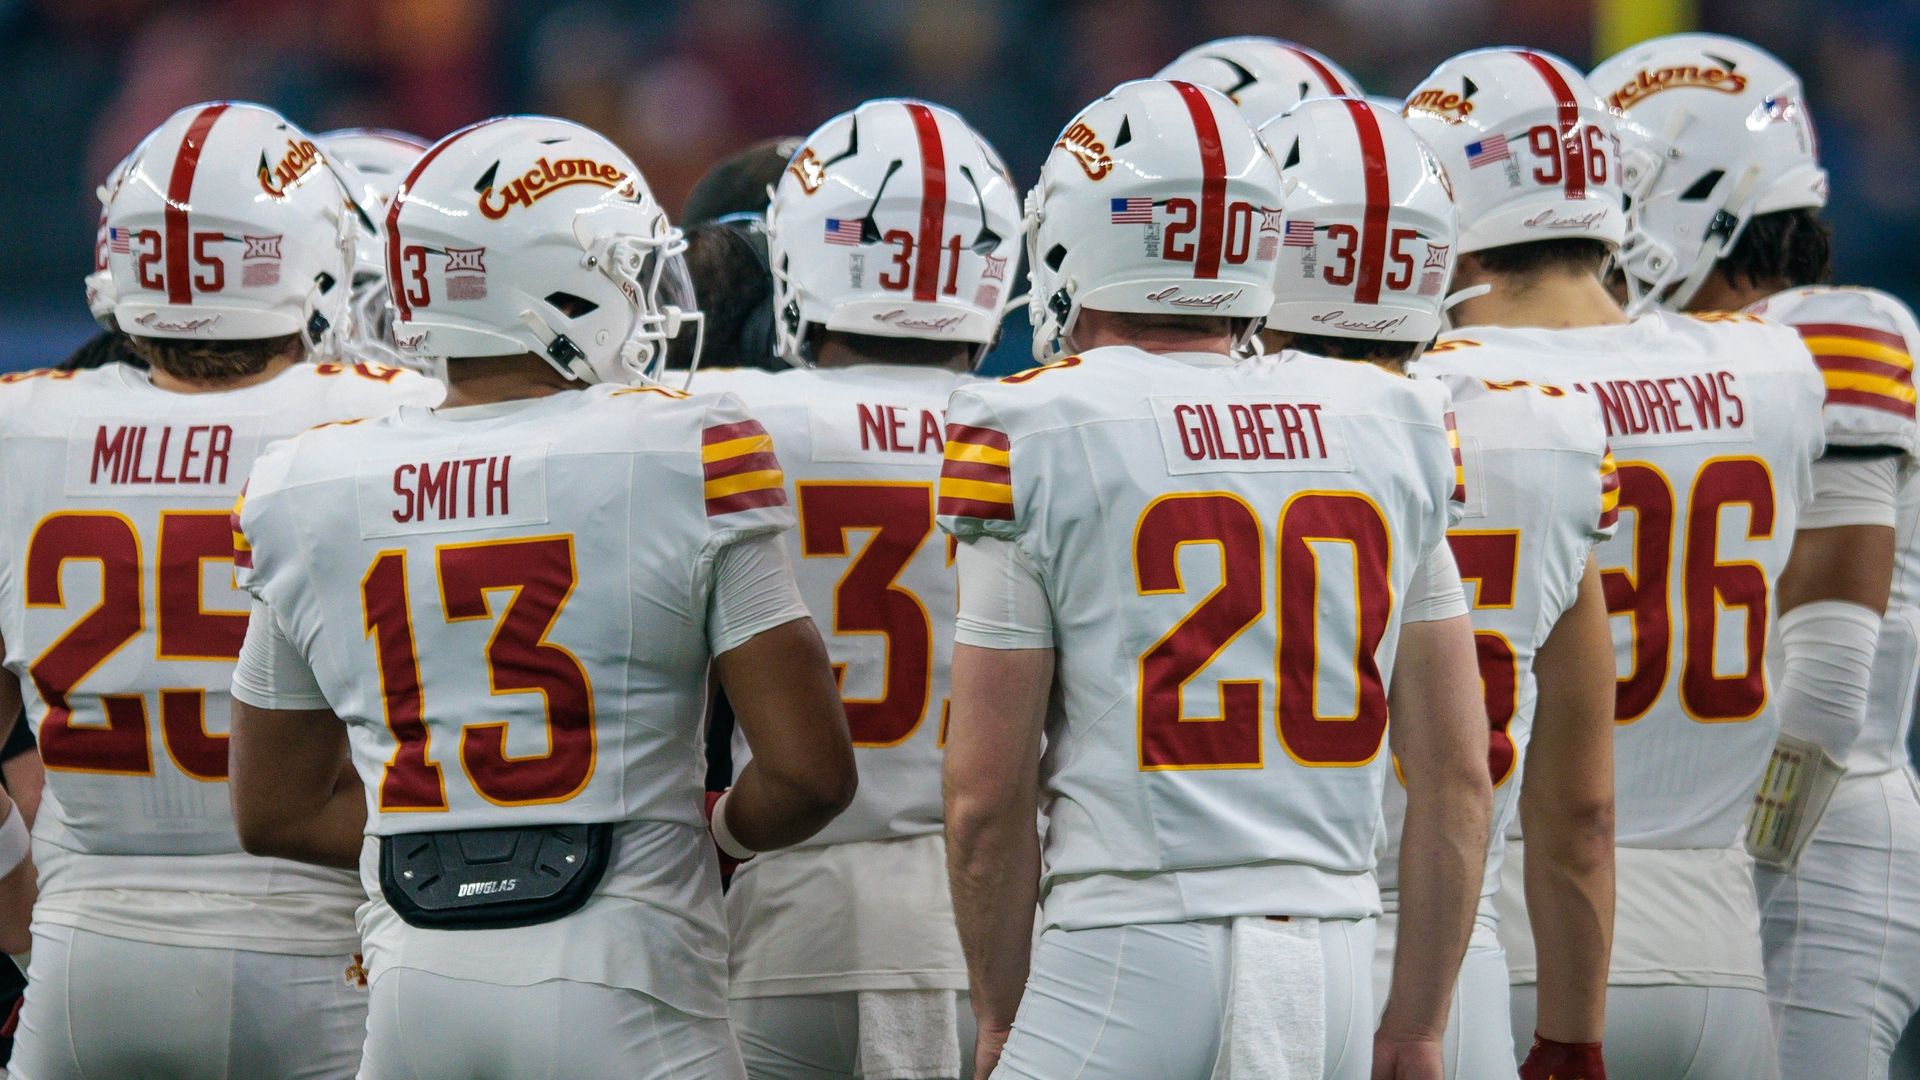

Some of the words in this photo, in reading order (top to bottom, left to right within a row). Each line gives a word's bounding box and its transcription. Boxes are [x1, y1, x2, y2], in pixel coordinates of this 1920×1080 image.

[1528, 124, 1607, 186] 96
[138, 229, 225, 292] 25
[879, 229, 962, 296] 31
[1162, 197, 1252, 265] 20
[1323, 224, 1418, 291] 35
[403, 246, 430, 307] 3
[856, 403, 947, 455] NEA
[1173, 403, 1329, 461] GILBERT
[1579, 370, 1746, 437] NDREWS
[90, 425, 233, 485] MILLER
[392, 455, 512, 524] SMITH
[795, 480, 959, 750] 3
[1132, 489, 1393, 772] 20
[360, 533, 600, 814] 13
[457, 879, 517, 897] DOUGLAS
